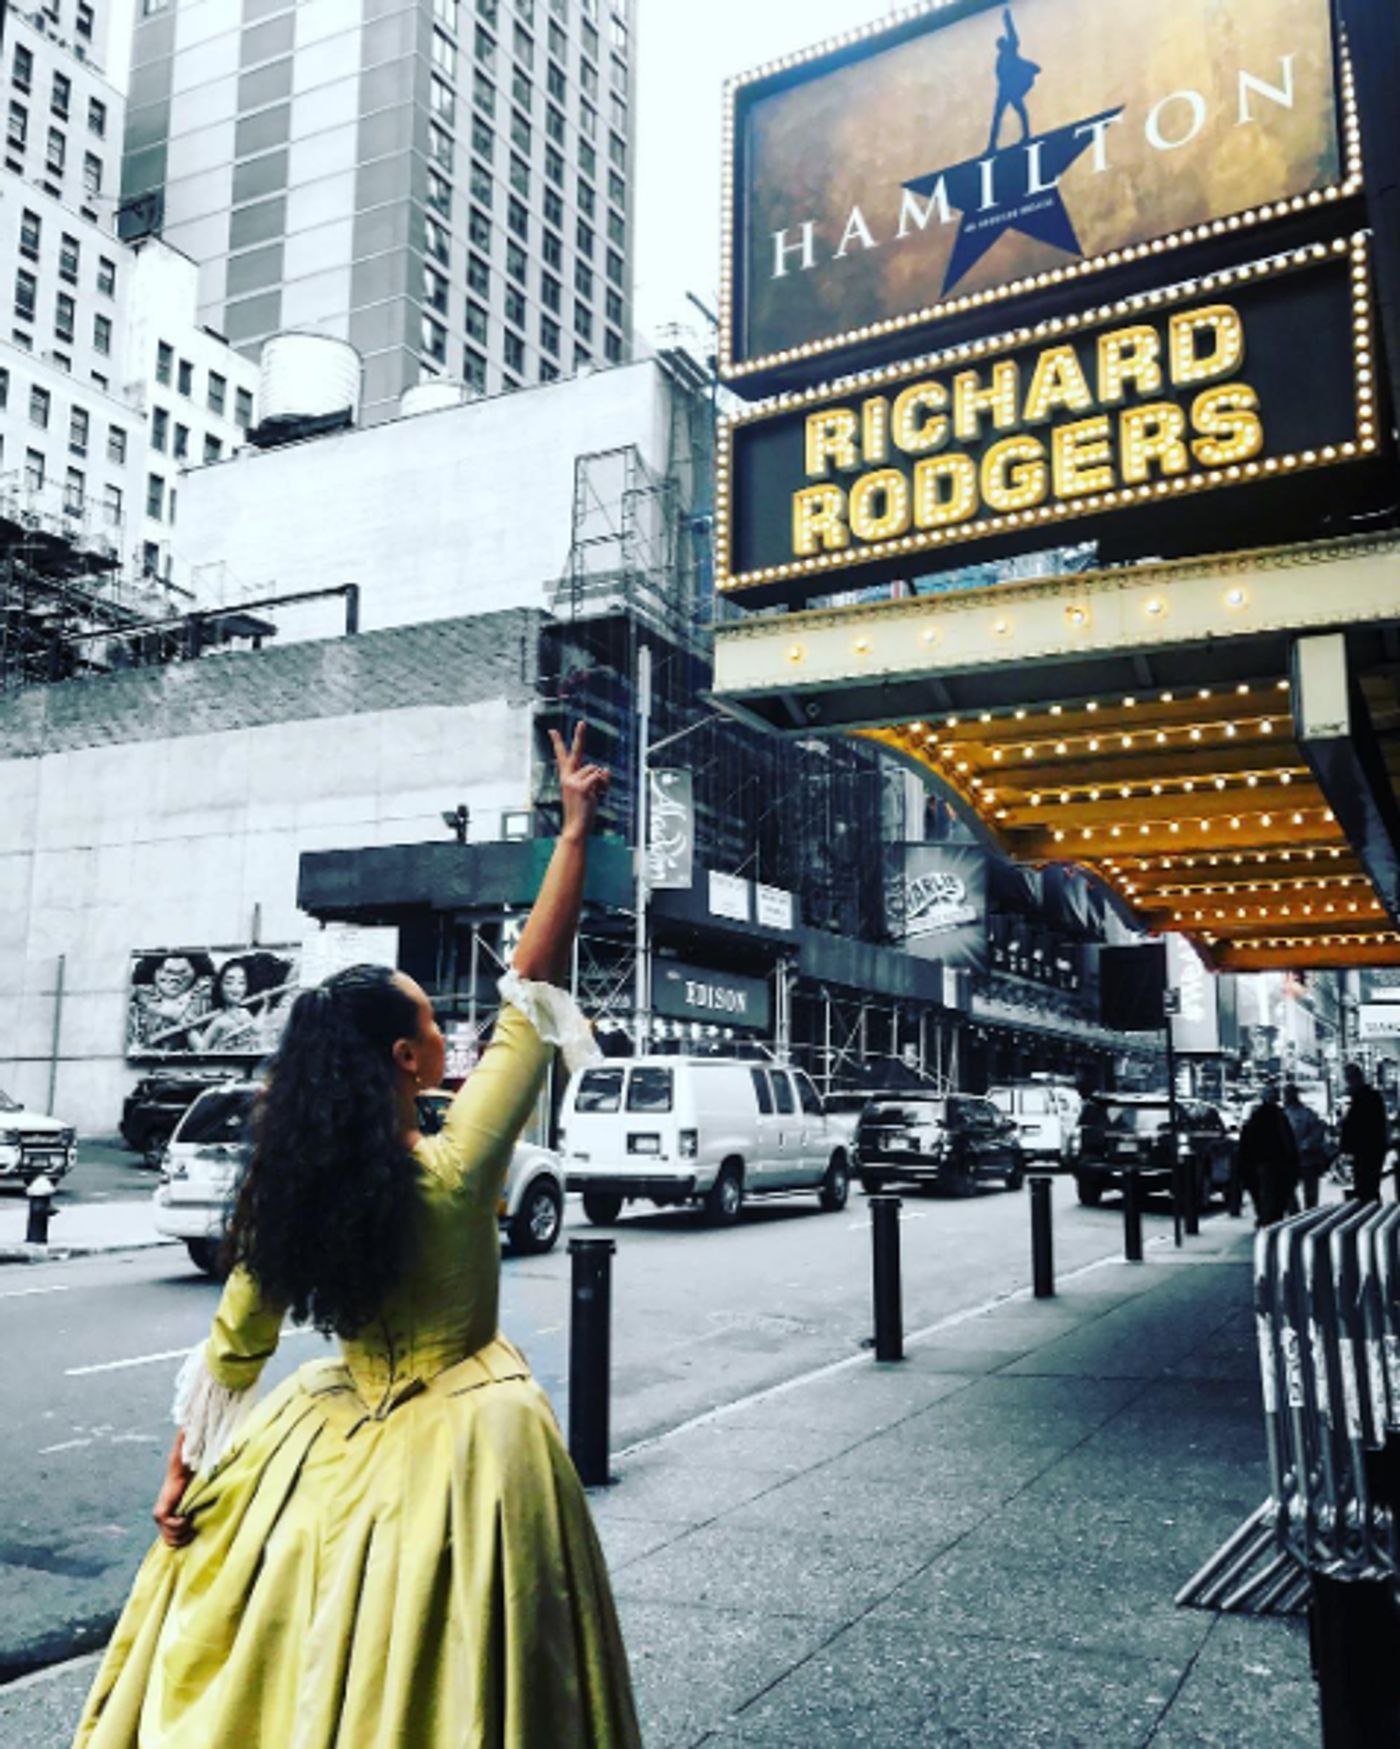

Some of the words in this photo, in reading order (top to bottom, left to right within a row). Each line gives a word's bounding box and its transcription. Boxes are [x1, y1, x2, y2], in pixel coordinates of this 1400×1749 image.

[770, 53, 1297, 280] HAMILTON
[792, 383, 1264, 556] RODGERS
[805, 304, 1244, 478] RICHARD
[685, 981, 747, 1013] EDISON
